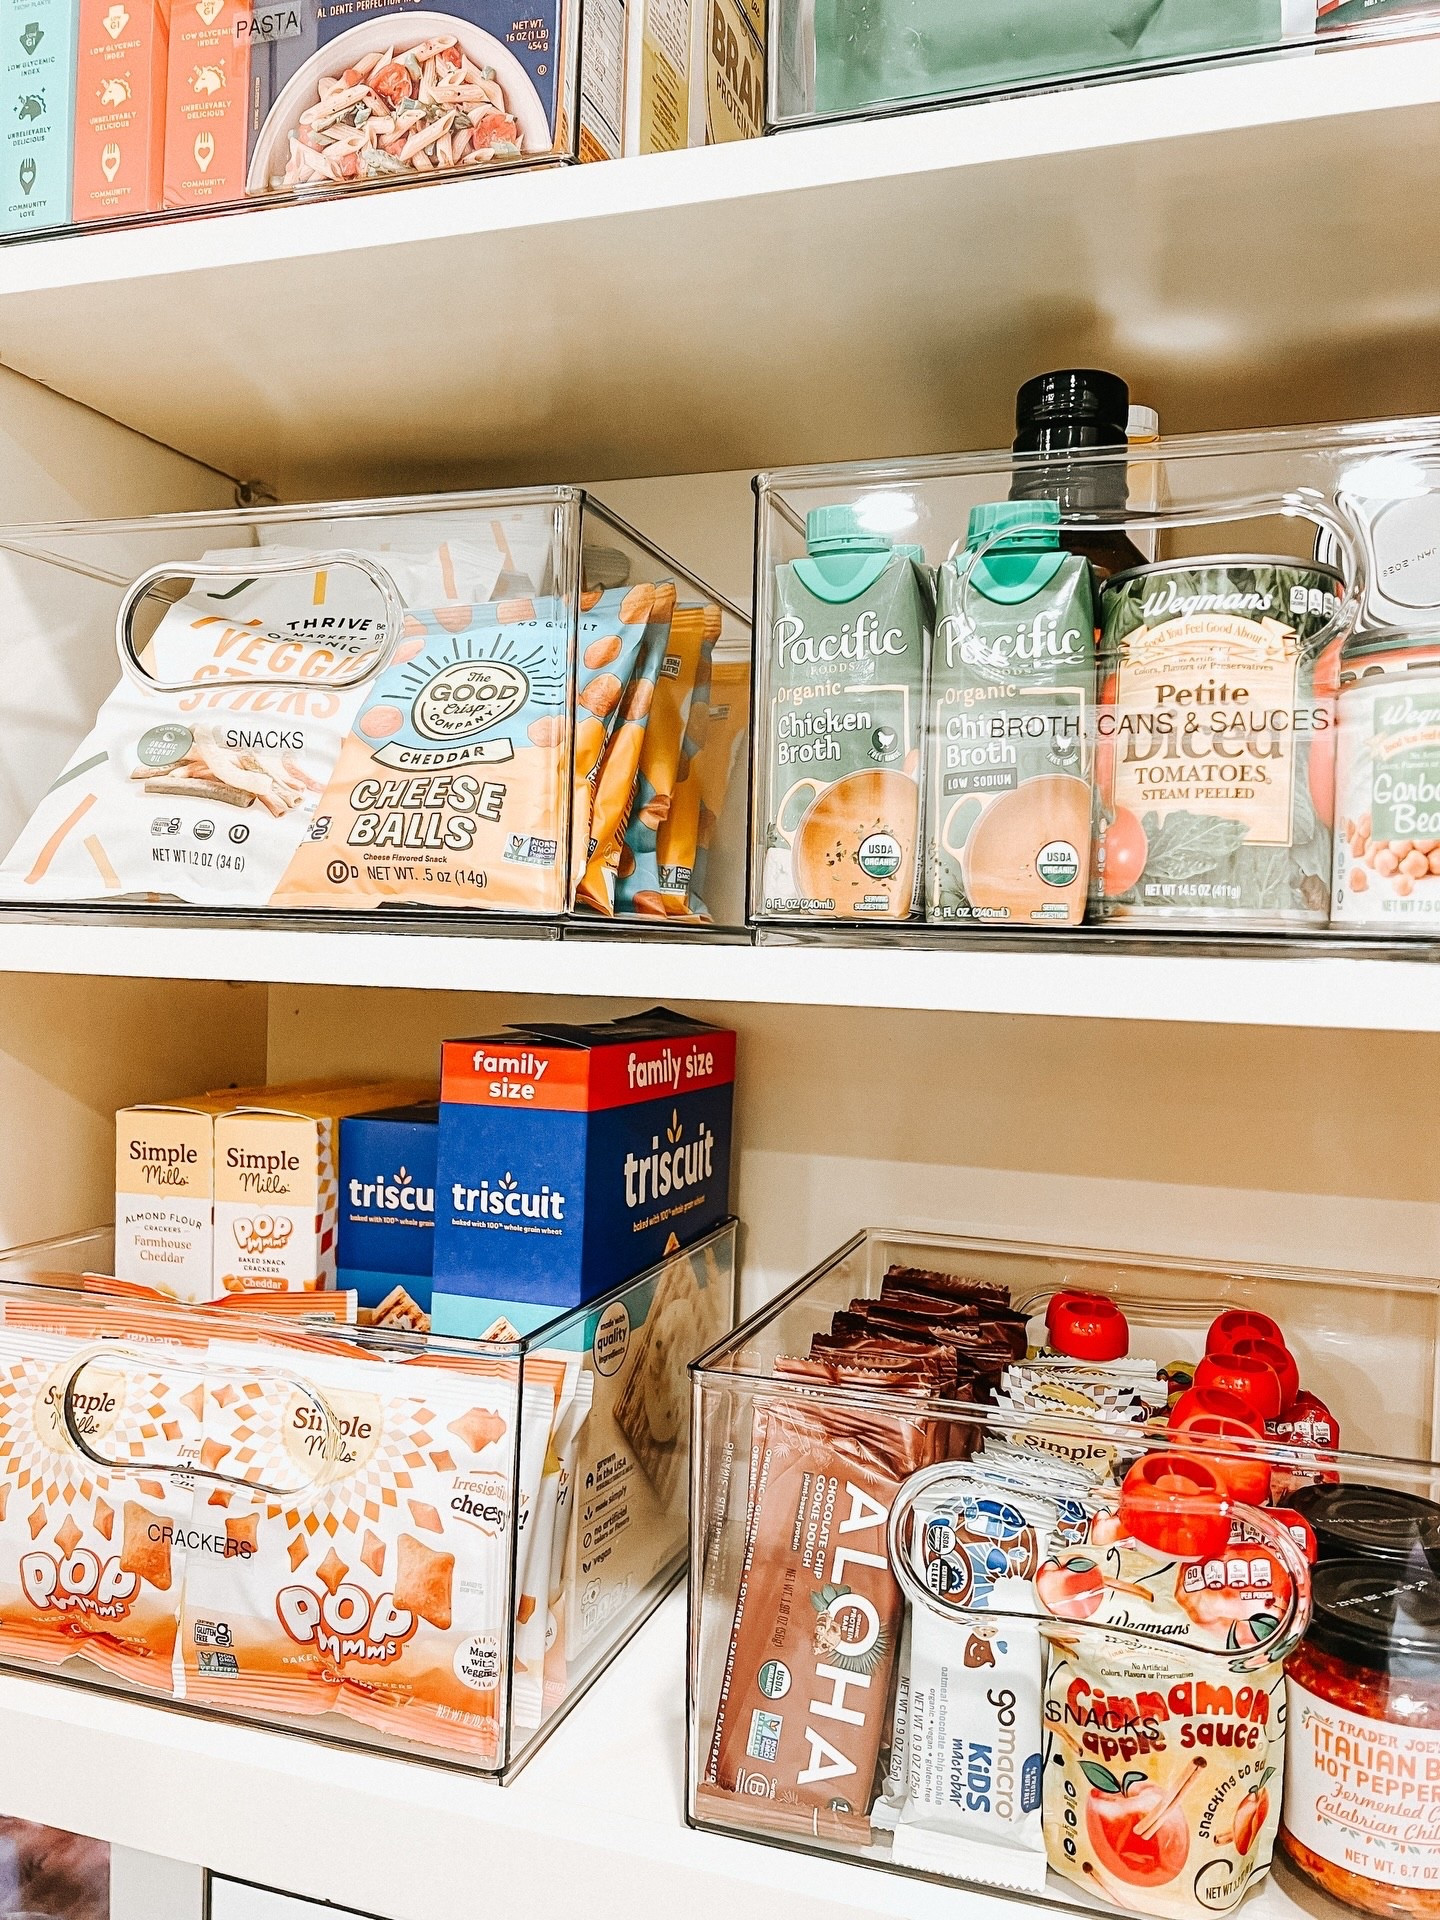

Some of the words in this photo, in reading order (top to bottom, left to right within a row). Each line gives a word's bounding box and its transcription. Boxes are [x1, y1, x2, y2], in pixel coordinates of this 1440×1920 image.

[317, 8, 327, 19] AL
[330, 3, 353, 16] DENTE
[181, 32, 198, 41] LOW
[236, 10, 299, 39] PASTA
[512, 21, 529, 31] NET
[197, 38, 219, 47] INDEX
[505, 32, 515, 42] 16
[104, 51, 125, 61] INDEX
[181, 100, 232, 113] UNBELIEVABLY
[187, 110, 225, 120] DELICIOUS
[715, 70, 751, 140] PROTEIN
[89, 111, 138, 125] UNBELIEVABLY
[95, 120, 129, 132] DELICIOUS
[12, 136, 45, 147] DELICIOUS
[90, 187, 132, 199] COMMUNITY
[181, 178, 226, 189] COMMUNITY
[194, 186, 213, 196] LOVE
[8, 200, 47, 212] COMMUNITY
[102, 197, 119, 205] LOVE
[19, 209, 35, 218] LOVE
[1140, 581, 1273, 624] Wegmans
[287, 617, 373, 631] THRIVE
[1185, 623, 1204, 636] Feel
[1206, 622, 1232, 635] Good
[772, 610, 908, 669] Pacific
[212, 628, 379, 679] VEGGIE
[467, 671, 492, 683] The
[810, 662, 856, 675] FOODS
[429, 684, 519, 702] GOOD
[777, 682, 841, 706] Organic
[945, 682, 1017, 707] Organic
[1156, 679, 1249, 708] Petite
[429, 710, 493, 730] COMPANY
[777, 707, 872, 739] Chicken
[991, 716, 1088, 738] BROTH,
[1098, 712, 1173, 736] CANS
[1184, 711, 1200, 735] &
[1210, 708, 1329, 733] SAUCES
[226, 729, 304, 749] SNACKS
[777, 735, 841, 765] Broth
[399, 746, 485, 765] CHEDDAR
[946, 739, 1017, 768] Broth
[948, 778, 968, 789] LOW
[974, 774, 1012, 788] SODIUM
[1135, 765, 1266, 785] TOMATOES
[349, 774, 507, 823] CHEESE
[1141, 789, 1190, 801] STEAM
[1194, 788, 1255, 800] PEELED
[347, 812, 477, 851] BALLS
[152, 848, 170, 862] NET
[172, 849, 187, 864] WT
[201, 852, 213, 867] OZ
[216, 854, 232, 870] (34
[363, 853, 390, 863] Cheese
[391, 854, 424, 864] Flavored
[425, 855, 448, 864] Snack
[869, 844, 893, 855] USDA
[1046, 852, 1072, 863] USDA
[863, 857, 897, 867] ORGANIC
[1042, 865, 1076, 875] ORGANIC
[367, 866, 390, 881] NET
[396, 866, 419, 881] WT.
[436, 871, 452, 884] oz
[455, 868, 489, 890] (14g)
[1145, 884, 1162, 897] NET
[1212, 884, 1241, 899] (411g)
[800, 898, 835, 910] (240mL)
[972, 907, 1010, 919] (240mL)
[473, 1050, 549, 1081] family
[627, 1048, 682, 1090] family
[685, 1044, 714, 1079] size
[488, 1077, 535, 1100] size
[129, 1140, 198, 1166] Simple
[226, 1147, 300, 1174] Simple
[624, 1122, 714, 1208] triscuit
[142, 1164, 188, 1186] Mills
[239, 1172, 290, 1194] Mills
[349, 1175, 435, 1212] triscu
[452, 1181, 565, 1220] triscuit
[125, 1212, 167, 1225] ALMOND
[170, 1213, 202, 1230] FLOUR
[144, 1225, 182, 1234] CRACKERS
[232, 1214, 293, 1250] POP
[350, 1214, 368, 1223] baked
[400, 1218, 418, 1226] whole
[419, 1220, 435, 1228] grain
[452, 1218, 470, 1227] baked
[471, 1220, 486, 1229] with
[504, 1223, 522, 1232] whole
[523, 1226, 540, 1234] grain
[541, 1226, 562, 1236] wheat
[134, 1234, 192, 1250] Farmhouse
[139, 1249, 185, 1265] Cheddar
[238, 1256, 261, 1266] BAKED
[262, 1257, 286, 1266] SNACK
[243, 1265, 280, 1273] CRACKERS
[242, 1277, 282, 1290] Cheddar
[597, 1327, 627, 1353] quality
[1023, 1434, 1107, 1459] Simple
[749, 1445, 759, 1494] ORGANIC
[758, 1449, 772, 1496] ORGANIC
[798, 1472, 811, 1521] plant-based
[811, 1475, 825, 1521] COOKIE
[821, 1478, 837, 1549] CHOCOLATE
[147, 1524, 252, 1560] CRACKERS
[744, 1505, 762, 1572] GLUTEN-FREE
[792, 1521, 801, 1551] protein
[803, 1523, 817, 1568] DOUGH
[813, 1550, 826, 1580] CHIP
[20, 1548, 140, 1611] POP
[276, 1583, 418, 1646] POP
[732, 1582, 749, 1630] SOY-FREE
[797, 1480, 890, 1785] ALOHA
[846, 1607, 857, 1641] PROTEIN
[772, 1627, 786, 1648] (56g)
[720, 1642, 737, 1702] DAIRY-FREE
[1142, 1663, 1169, 1671] Artificial
[775, 1670, 785, 1692] USDA
[902, 1676, 910, 1696] NET
[940, 1666, 948, 1702] oatmeal
[916, 1691, 925, 1709] NET
[1067, 1677, 1270, 1729] Cinnamon
[938, 1704, 947, 1752] chocolate
[1045, 1700, 1159, 1740] SNACKS
[1082, 1730, 1167, 1763] apple
[1180, 1723, 1259, 1750] sauce
[1338, 1720, 1398, 1749] TRADER
[708, 1711, 725, 1784] PLANT-BASED
[1314, 1725, 1421, 1780] ITALIAN
[924, 1758, 932, 1803] gluten-free
[949, 1738, 963, 1811] macrobar
[967, 1742, 993, 1814] KiDS
[1314, 1750, 1351, 1783] HOT
[1356, 1770, 1440, 1803] PEPPER
[934, 1772, 943, 1805] cookie
[1199, 1775, 1237, 1838] snacking
[1331, 1782, 1426, 1821] Fermented
[1316, 1795, 1399, 1834] Calabrian
[1345, 1847, 1368, 1867] NET
[1374, 1859, 1395, 1876] WT.
[1400, 1864, 1419, 1879] 6.7
[1423, 1865, 1440, 1881] OZ
[1206, 1886, 1221, 1900] NET
